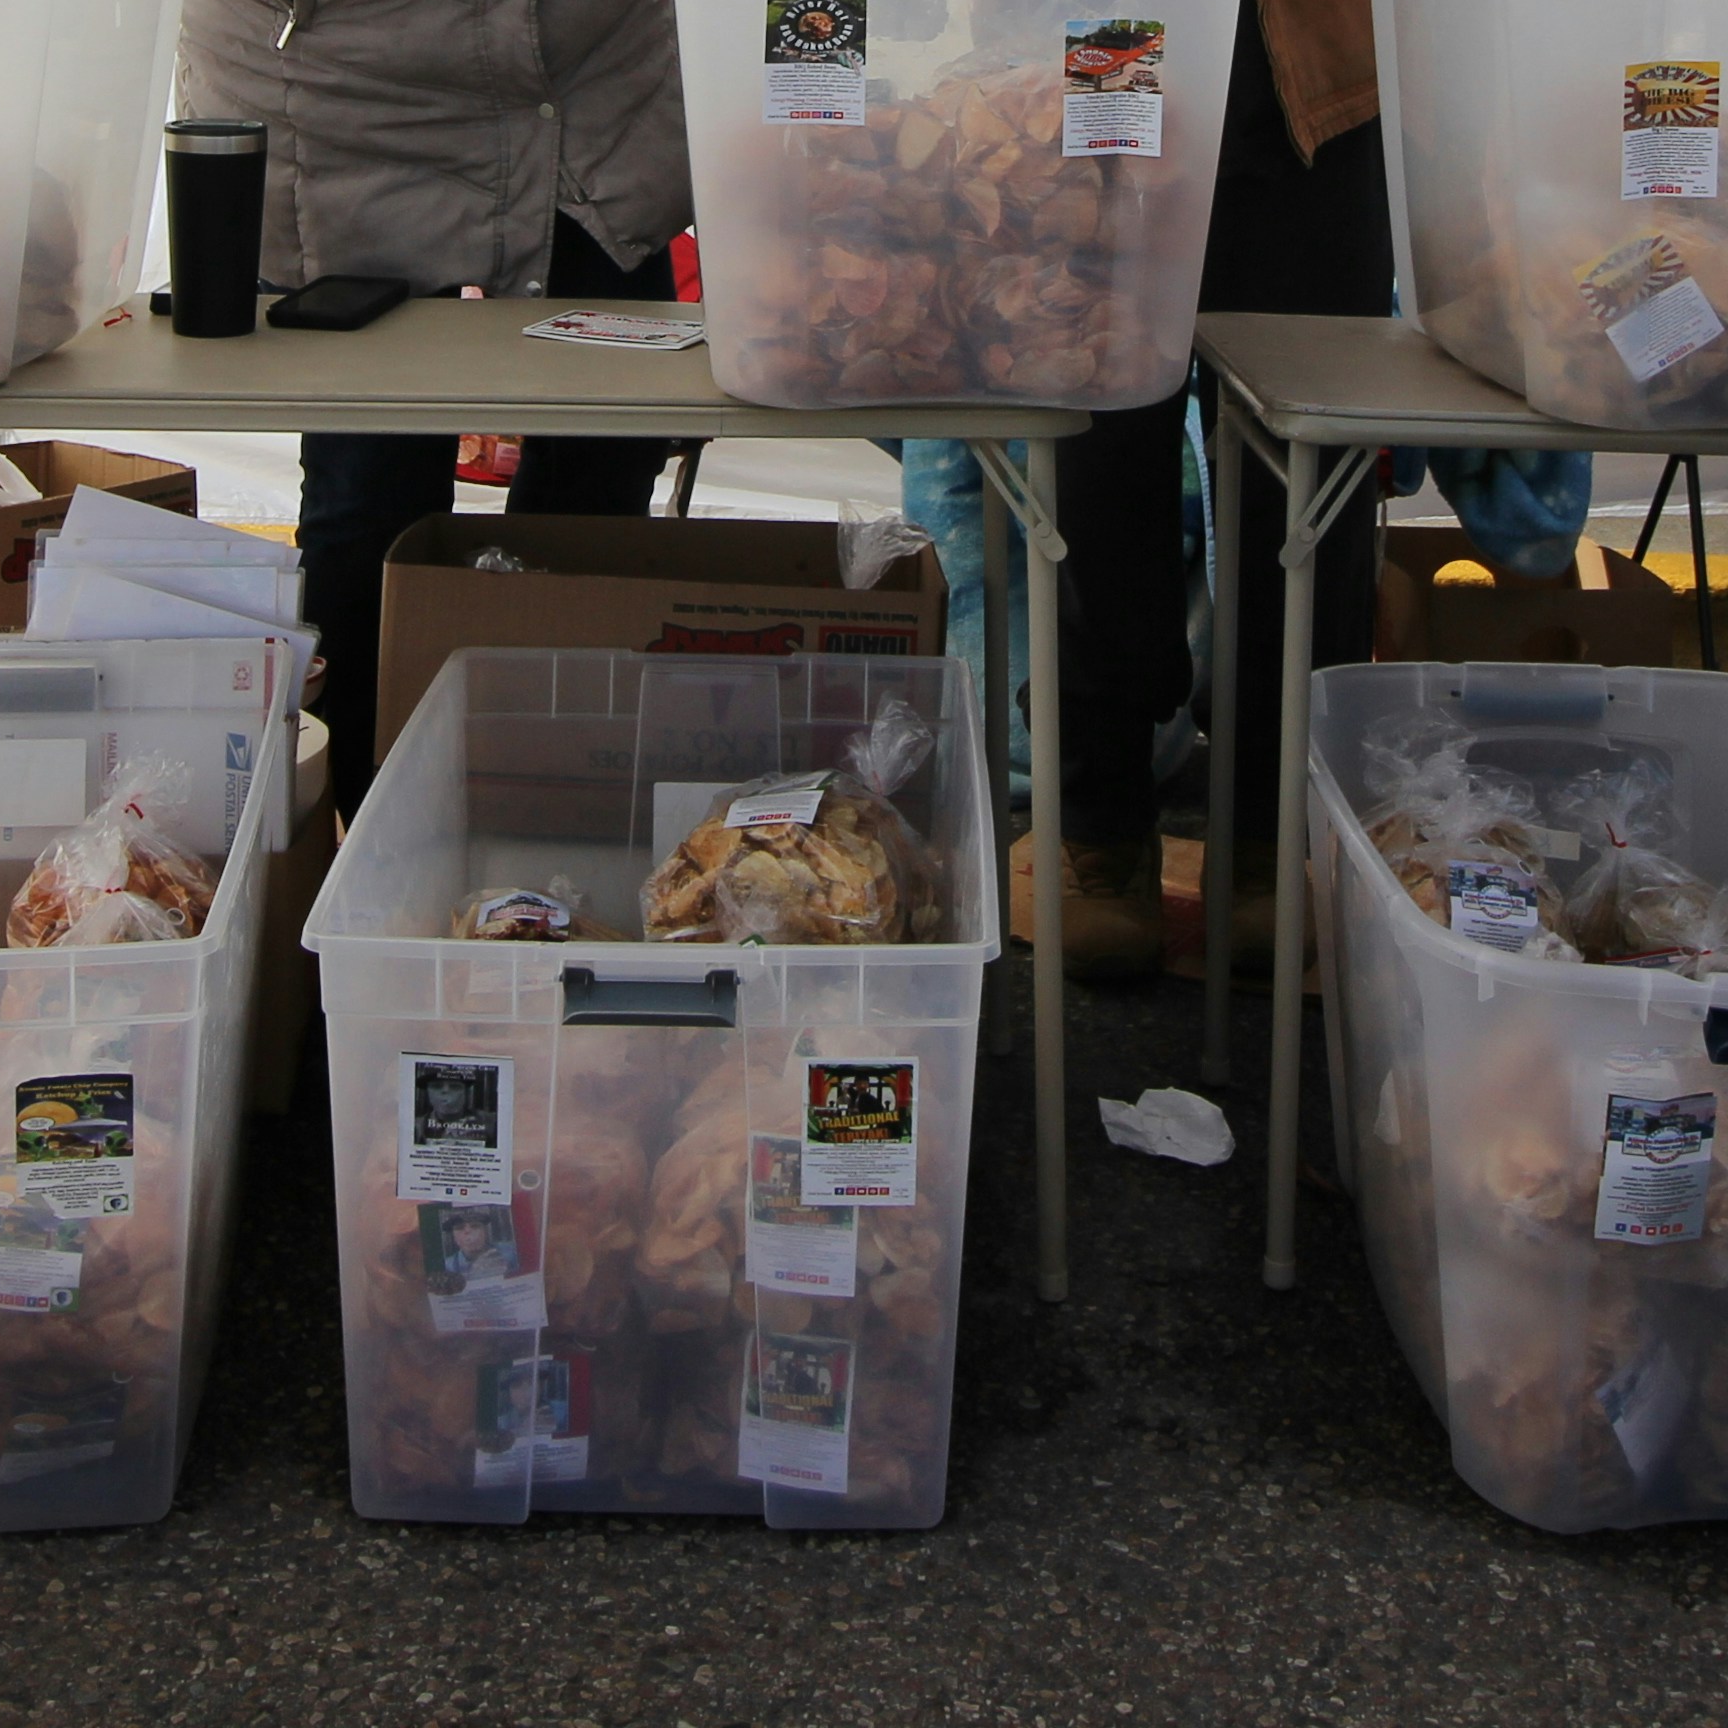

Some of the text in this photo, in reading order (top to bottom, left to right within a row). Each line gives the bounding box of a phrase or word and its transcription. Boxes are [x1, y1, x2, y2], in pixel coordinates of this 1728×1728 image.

[786, 0, 823, 19] River
[225, 774, 237, 820] POSTAL
[819, 1110, 901, 1129] TRADITIONAL
[833, 1128, 889, 1142] TERIYAKI
